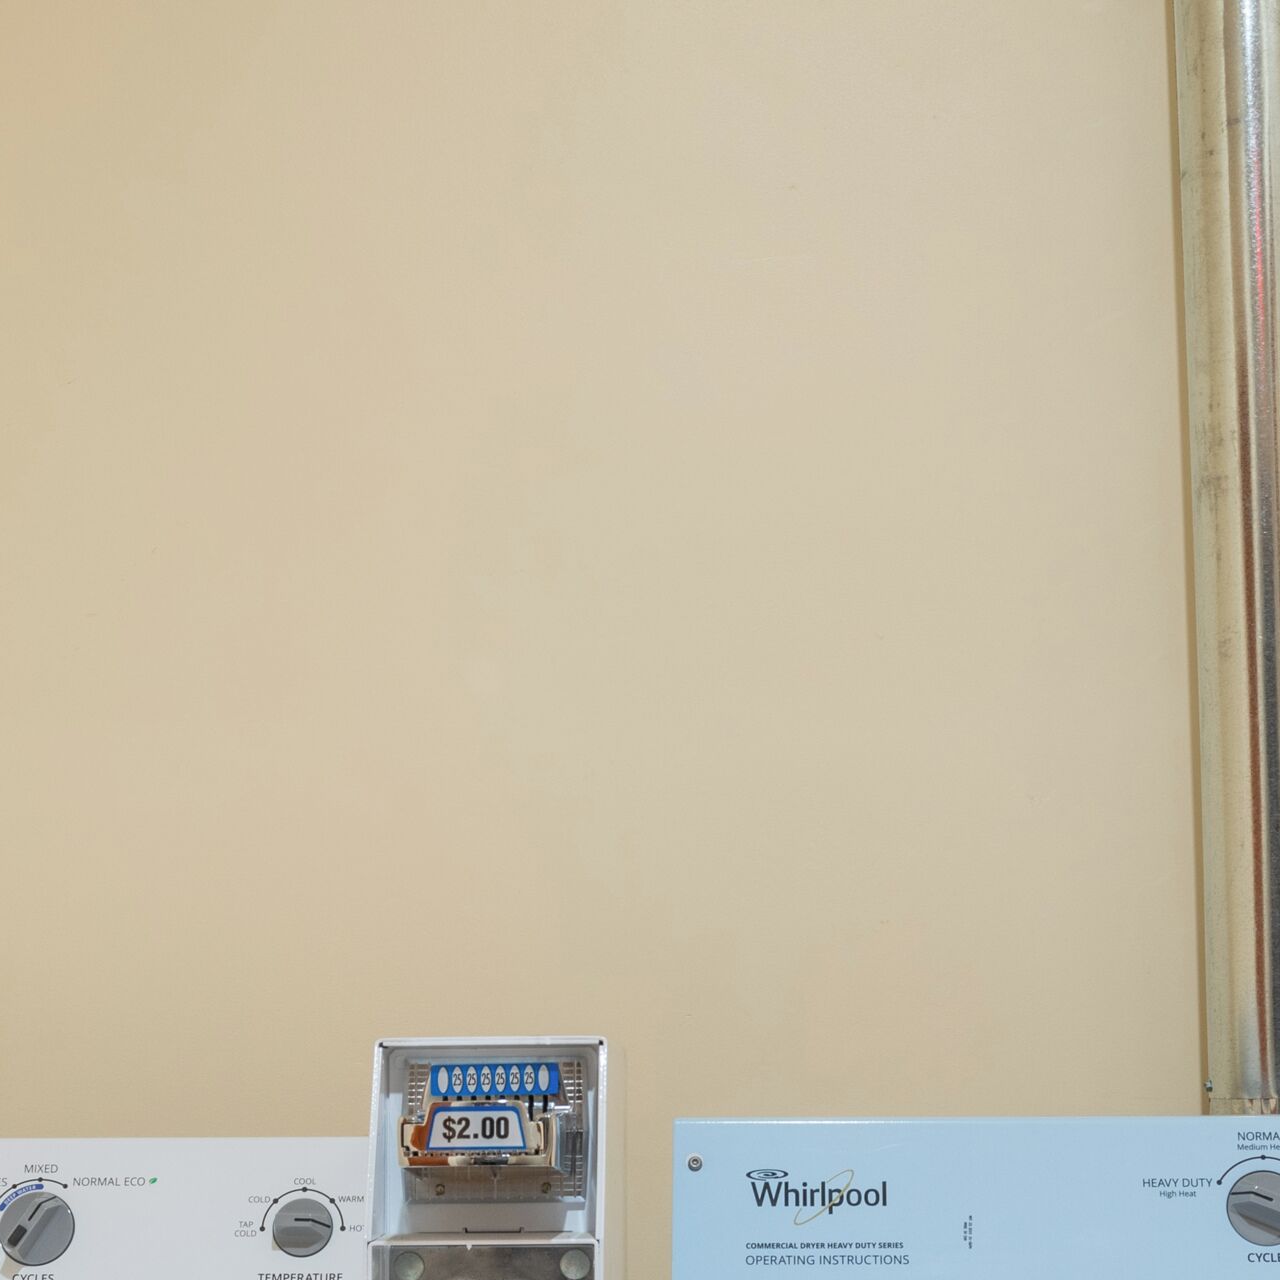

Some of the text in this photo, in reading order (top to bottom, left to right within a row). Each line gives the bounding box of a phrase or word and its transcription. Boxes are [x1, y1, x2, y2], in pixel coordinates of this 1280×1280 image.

[443, 1116, 509, 1143] $2.00
[24, 1164, 59, 1174] MIXED
[73, 1177, 146, 1187] NORMAL ECO
[294, 1178, 317, 1186] COOL
[1143, 1178, 1213, 1188] HEAVY DUTY
[248, 1196, 271, 1204] COLD
[751, 1181, 887, 1214] Whirlpool
[1160, 1190, 1177, 1200] High
[239, 1221, 254, 1229] TAP
[234, 1230, 258, 1238] COLD
[855, 1242, 877, 1250] DUTY
[746, 1255, 909, 1265] OPERATING INSTRUCTIONS
